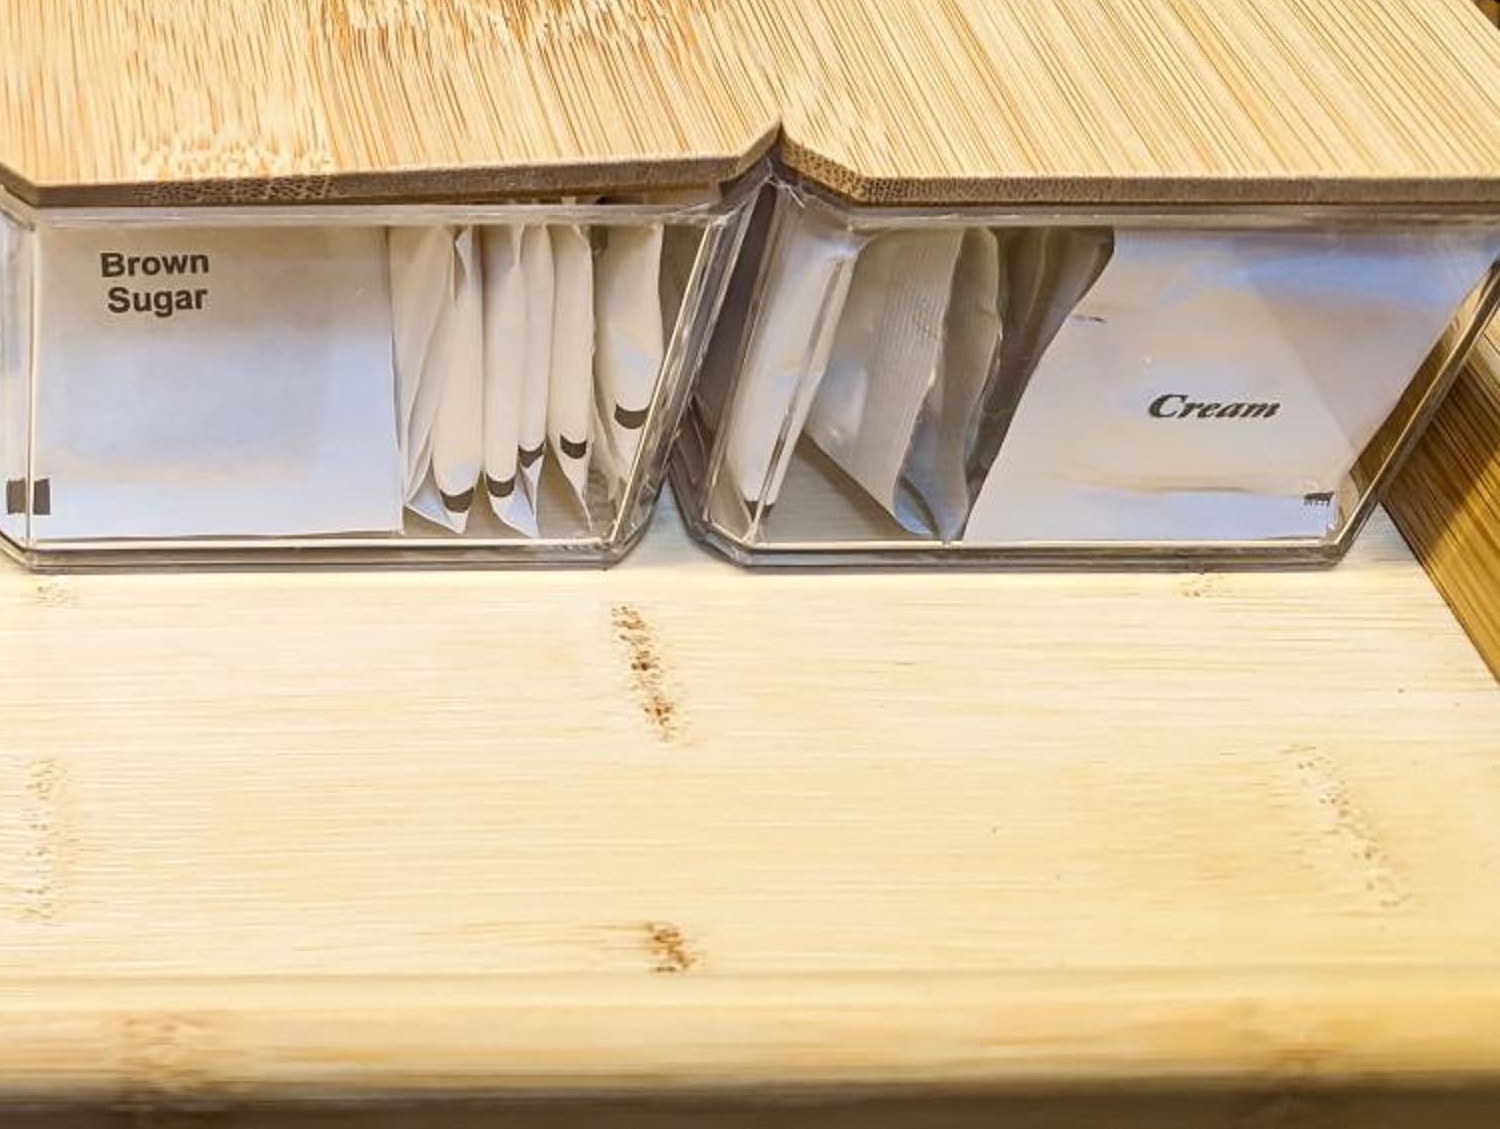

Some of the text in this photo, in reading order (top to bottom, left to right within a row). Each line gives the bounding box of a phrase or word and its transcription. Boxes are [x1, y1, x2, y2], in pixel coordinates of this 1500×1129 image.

[100, 250, 209, 277] Brown
[107, 285, 208, 318] Sugar
[1149, 394, 1281, 420] Cream
